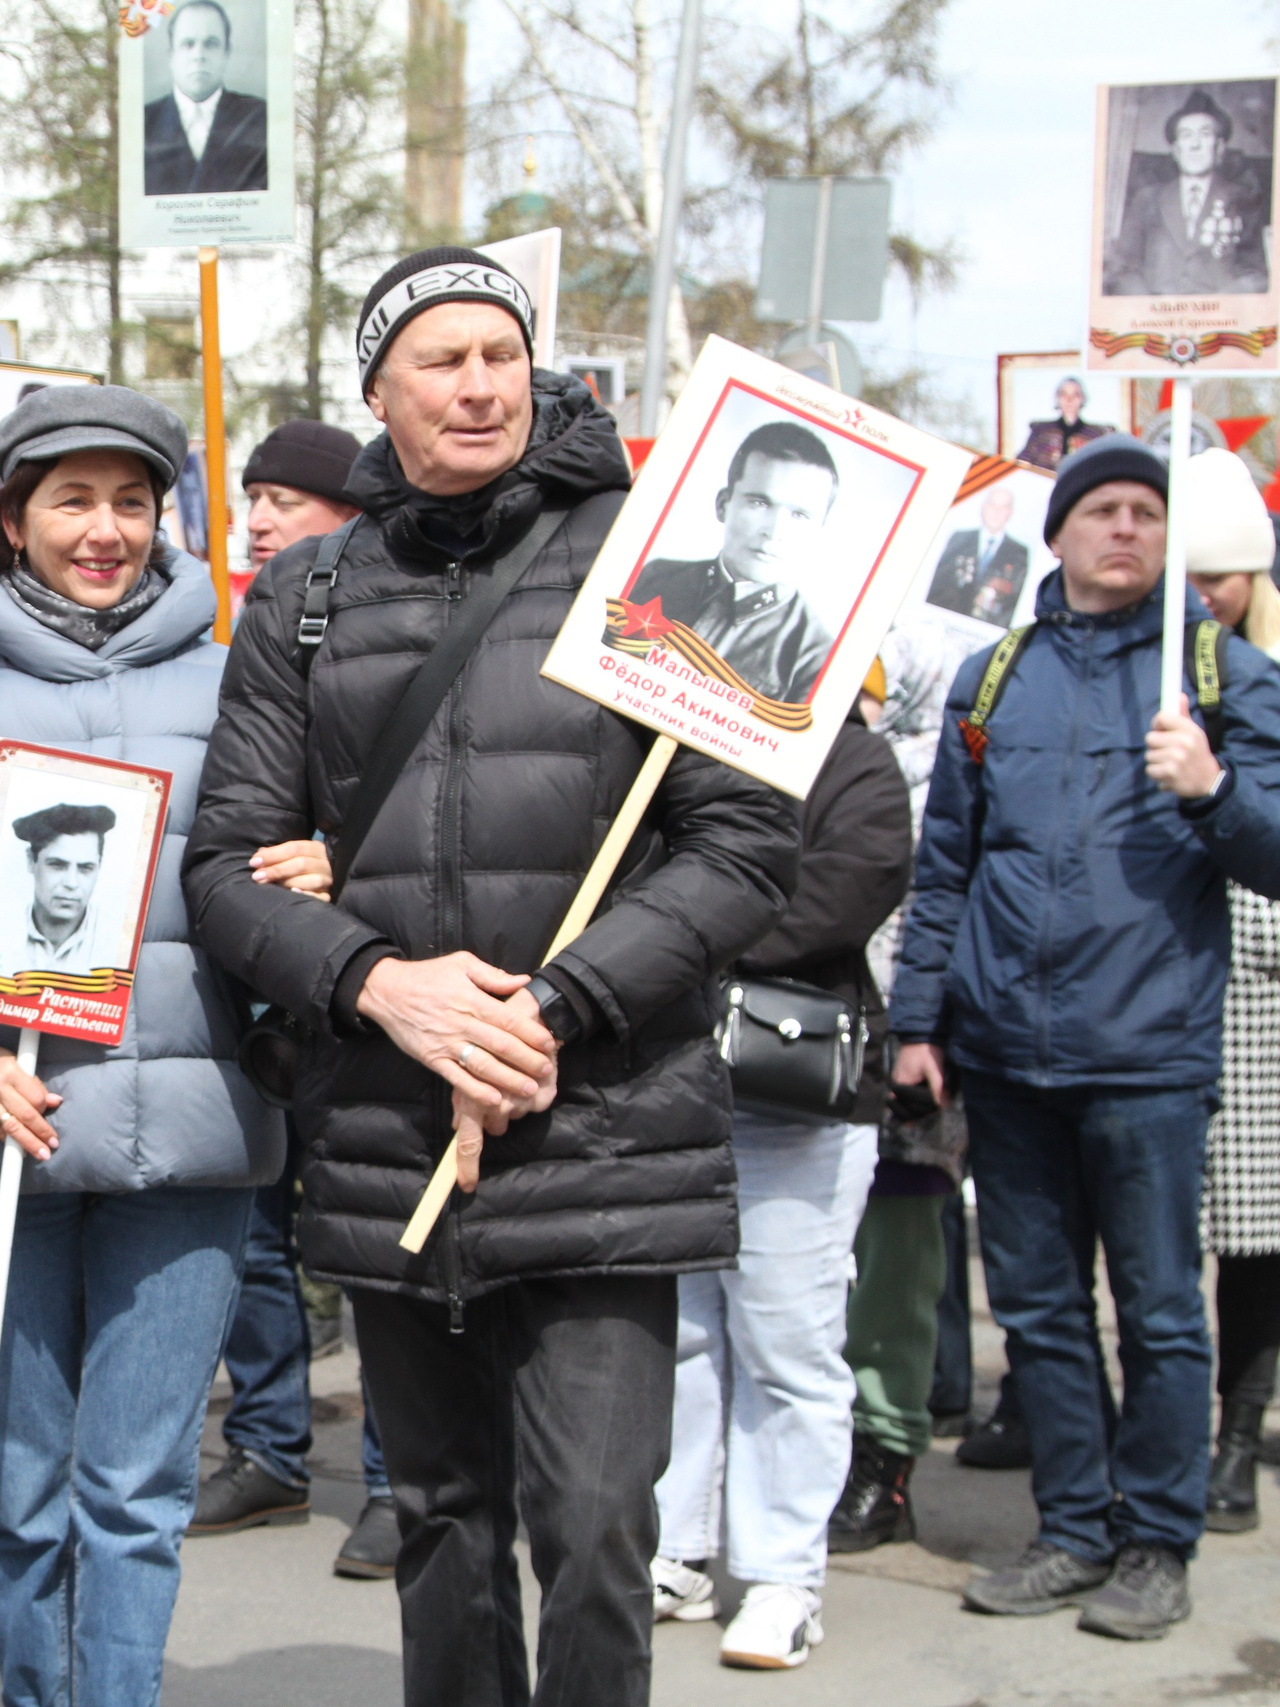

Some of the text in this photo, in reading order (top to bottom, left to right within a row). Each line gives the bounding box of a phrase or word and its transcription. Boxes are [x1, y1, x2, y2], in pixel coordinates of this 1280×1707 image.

[599, 655, 780, 752] Фёдор Акимович
[647, 648, 753, 711] Малышев
[614, 689, 743, 758] участник войны
[38, 986, 123, 1020] Распутин
[40, 1007, 120, 1035] Васильевич
